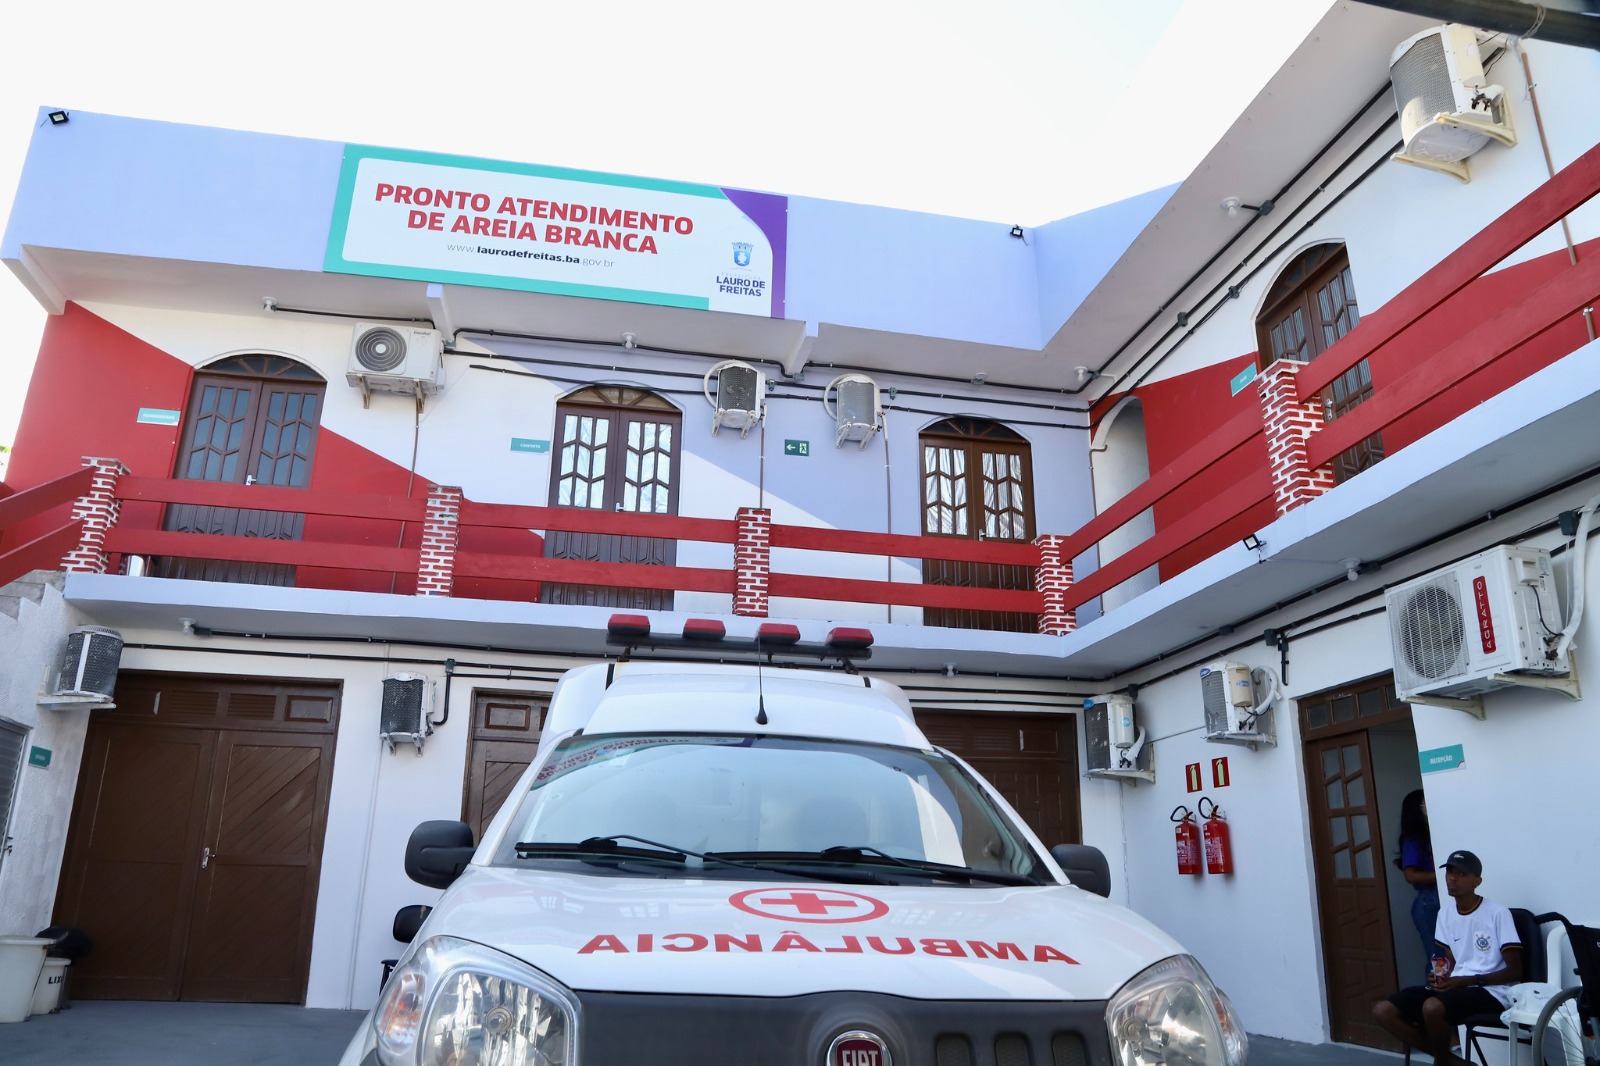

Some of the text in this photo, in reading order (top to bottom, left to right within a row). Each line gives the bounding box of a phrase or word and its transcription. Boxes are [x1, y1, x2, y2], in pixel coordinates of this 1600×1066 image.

[375, 183, 694, 235] PRONTO ATENDIMENTO
[407, 210, 658, 254] DE AREIA BRANCA
[446, 244, 615, 267] www.laurodefreitas.ba.gov.br
[716, 275, 766, 289] LAURO DE
[719, 284, 762, 297] FREITAS
[842, 1050, 879, 1066] FIAT
